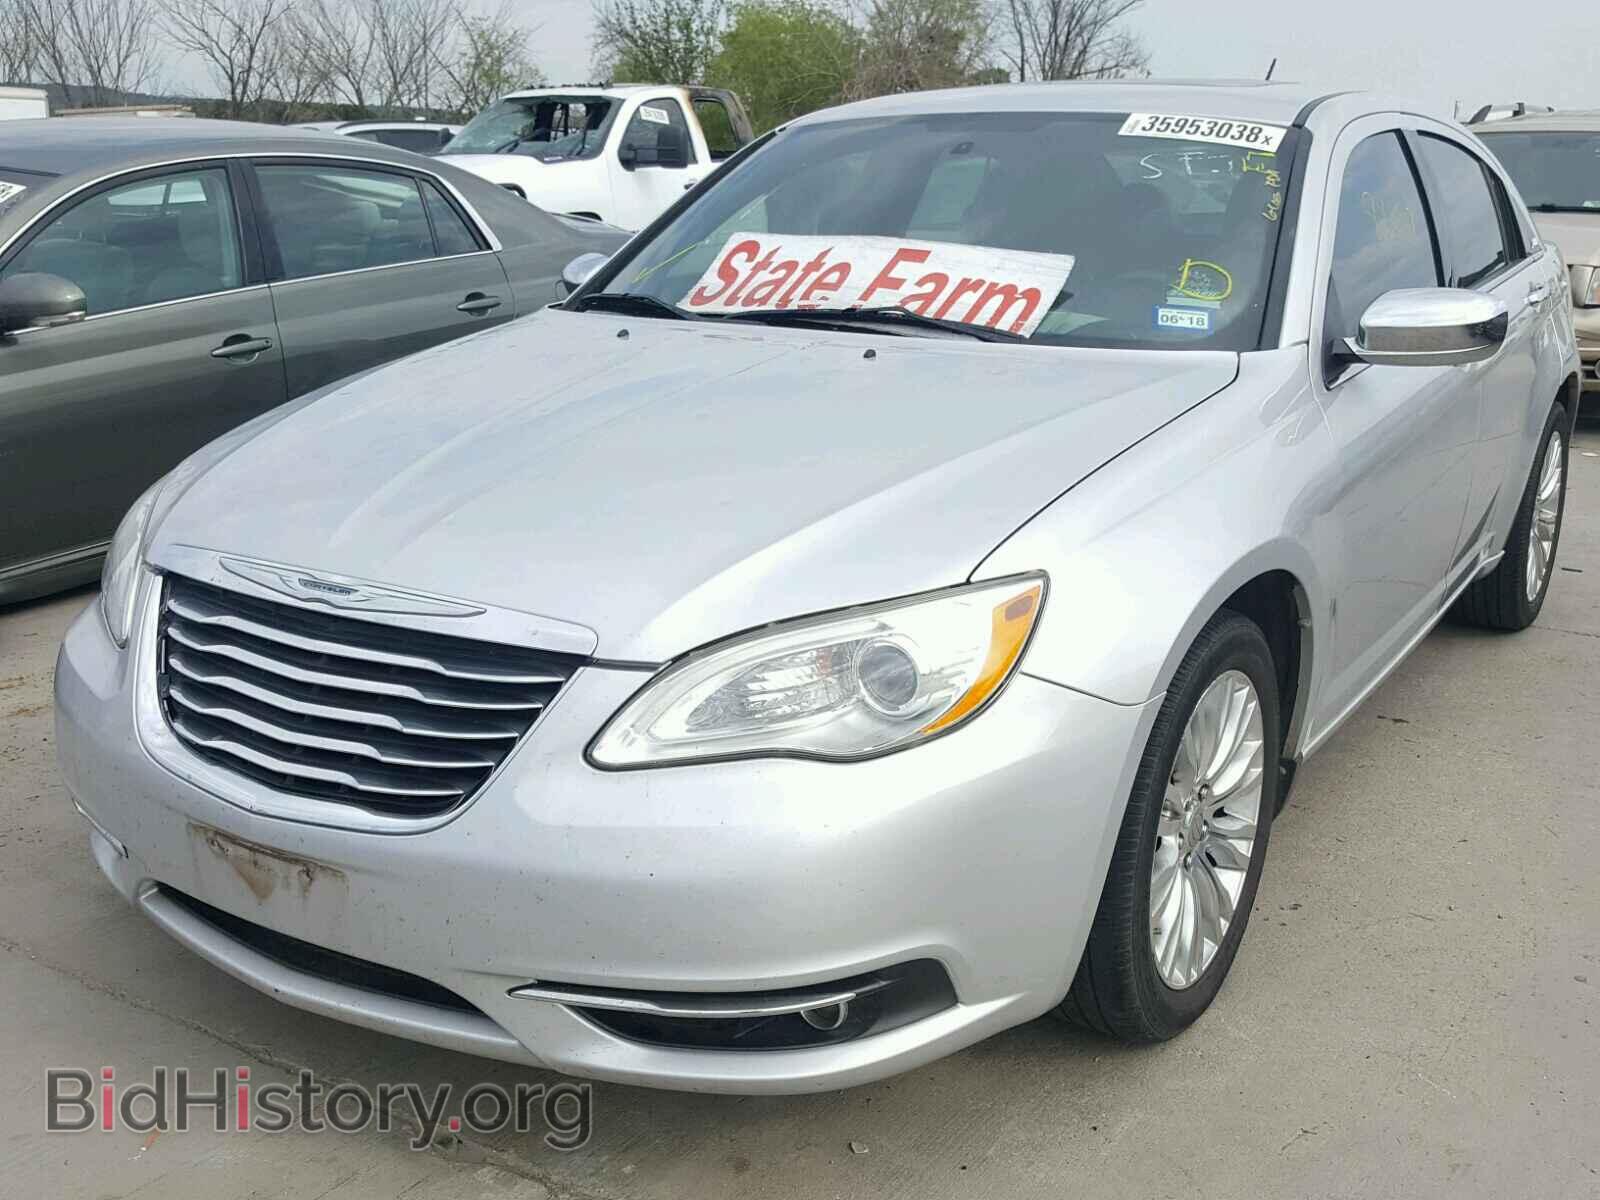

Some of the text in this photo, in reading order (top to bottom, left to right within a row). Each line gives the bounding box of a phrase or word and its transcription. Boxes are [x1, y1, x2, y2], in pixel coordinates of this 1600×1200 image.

[1141, 115, 1262, 144] 35953038
[689, 239, 1042, 334] State Farm
